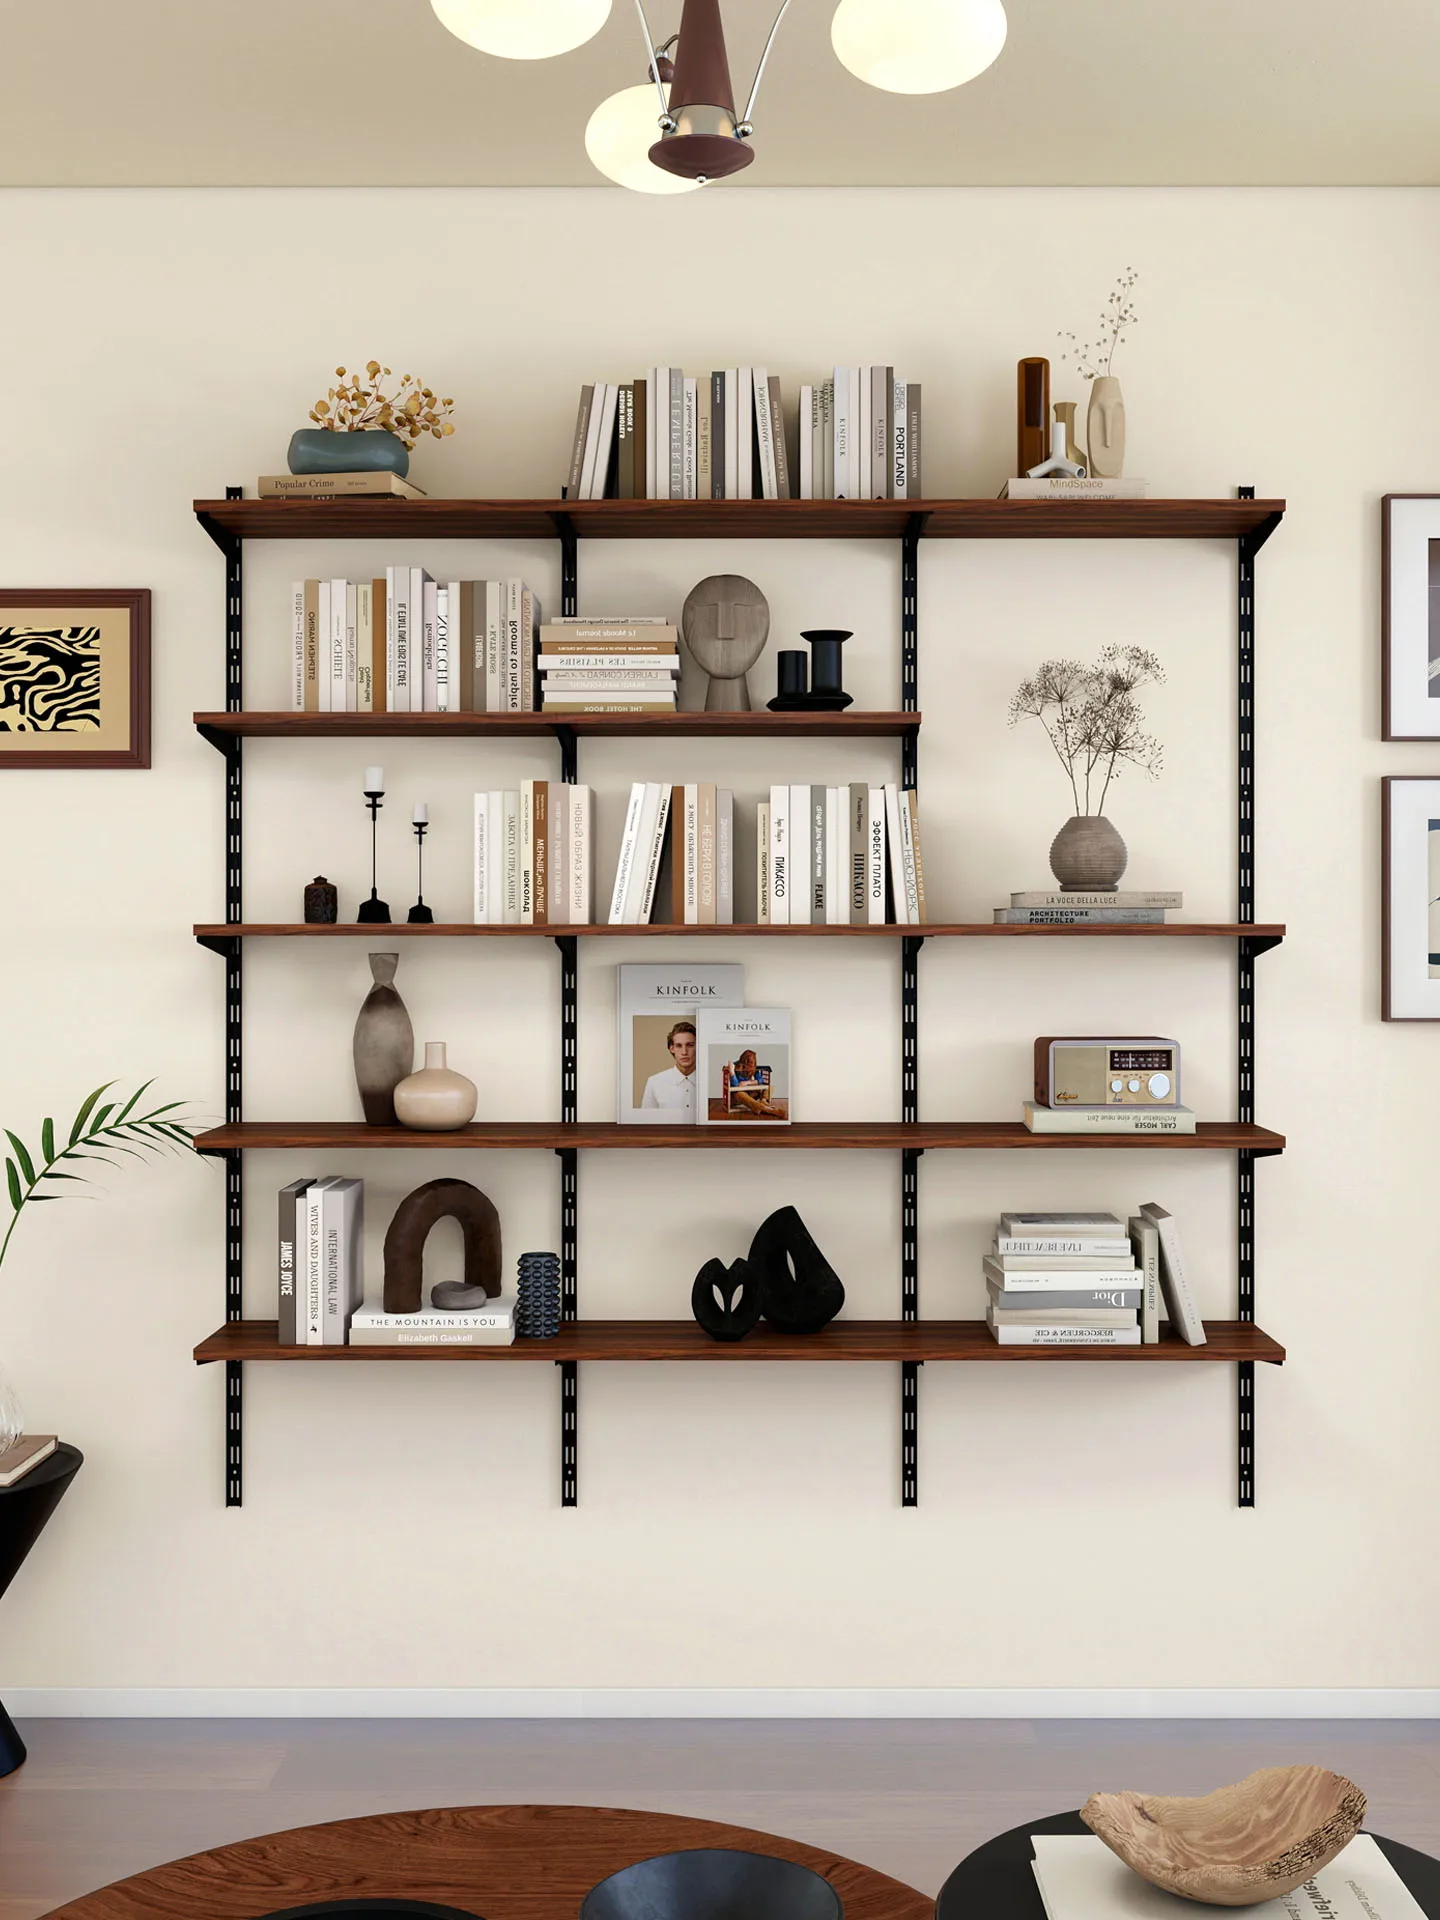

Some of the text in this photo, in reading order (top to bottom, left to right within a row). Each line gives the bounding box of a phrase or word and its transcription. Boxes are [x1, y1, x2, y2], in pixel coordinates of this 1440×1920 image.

[896, 427, 904, 487] PORTLAND
[275, 480, 307, 489] Popular
[1050, 480, 1103, 488] MindSpace
[702, 824, 712, 836] НЕ
[574, 803, 583, 909] НОВЫЙ ОБРАЗ ЖИЗНИ
[702, 838, 712, 861] БЕРИ
[872, 820, 881, 898] ЭФФЕКТ ПЛАТО
[702, 871, 712, 906] ГОЛОВУ
[775, 857, 785, 897] ПИКАССО
[853, 853, 864, 909] ПИКАССО
[904, 849, 917, 911] НЬЮ-ЙОРК
[815, 884, 823, 909] FLAKE
[657, 986, 717, 995] KINFOLK
[280, 1241, 293, 1296] JAMES JOYCE
[310, 1205, 319, 1320] WIVES AND DAUGHTERS
[328, 1229, 338, 1315] INTERNATIONAL LAW
[1092, 1291, 1126, 1307] Dior
[398, 1334, 473, 1342] Elizabeth Gaskell
